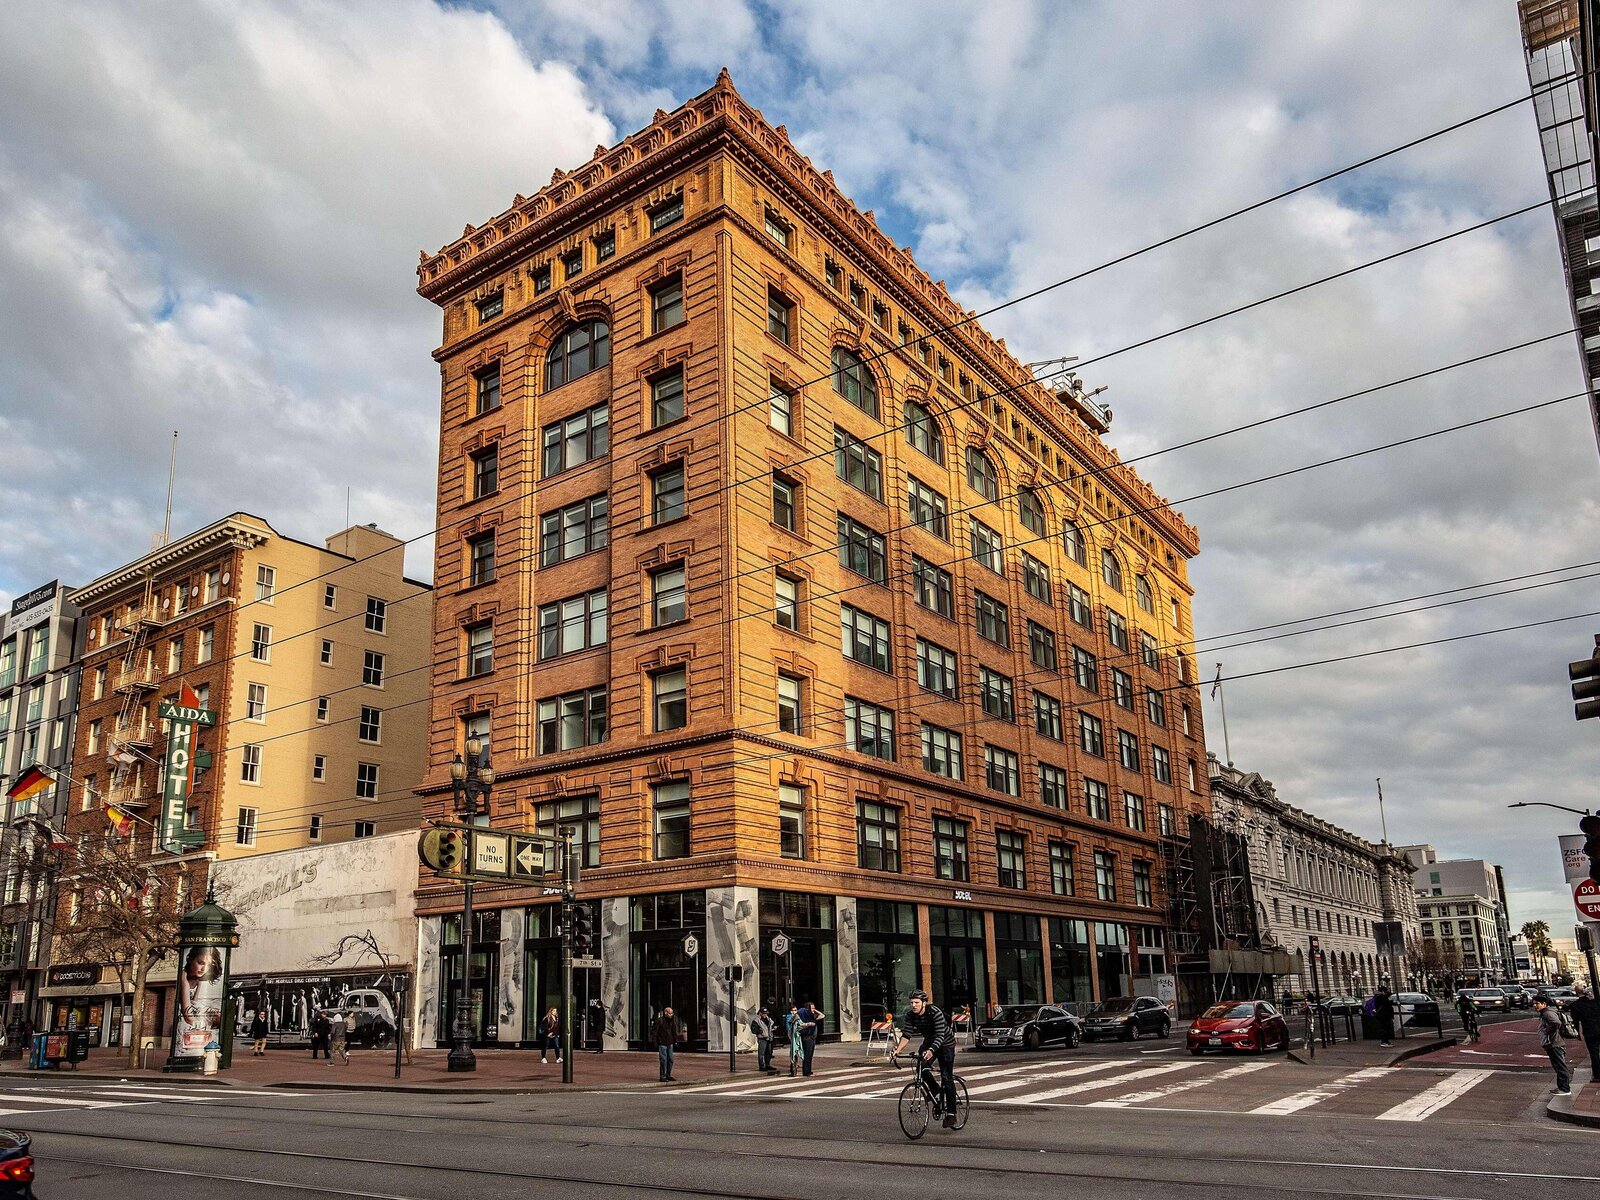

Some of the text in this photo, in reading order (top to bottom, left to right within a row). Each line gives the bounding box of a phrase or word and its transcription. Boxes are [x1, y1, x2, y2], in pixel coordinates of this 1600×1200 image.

[166, 705, 210, 723] AIDA
[166, 722, 191, 845] HOTEL
[486, 845, 497, 854] NO
[479, 853, 504, 864] TURNS
[520, 854, 530, 862] ONE
[1565, 855, 1586, 863] Care
[232, 864, 318, 909] ERRILL'S
[1581, 886, 1595, 894] DO
